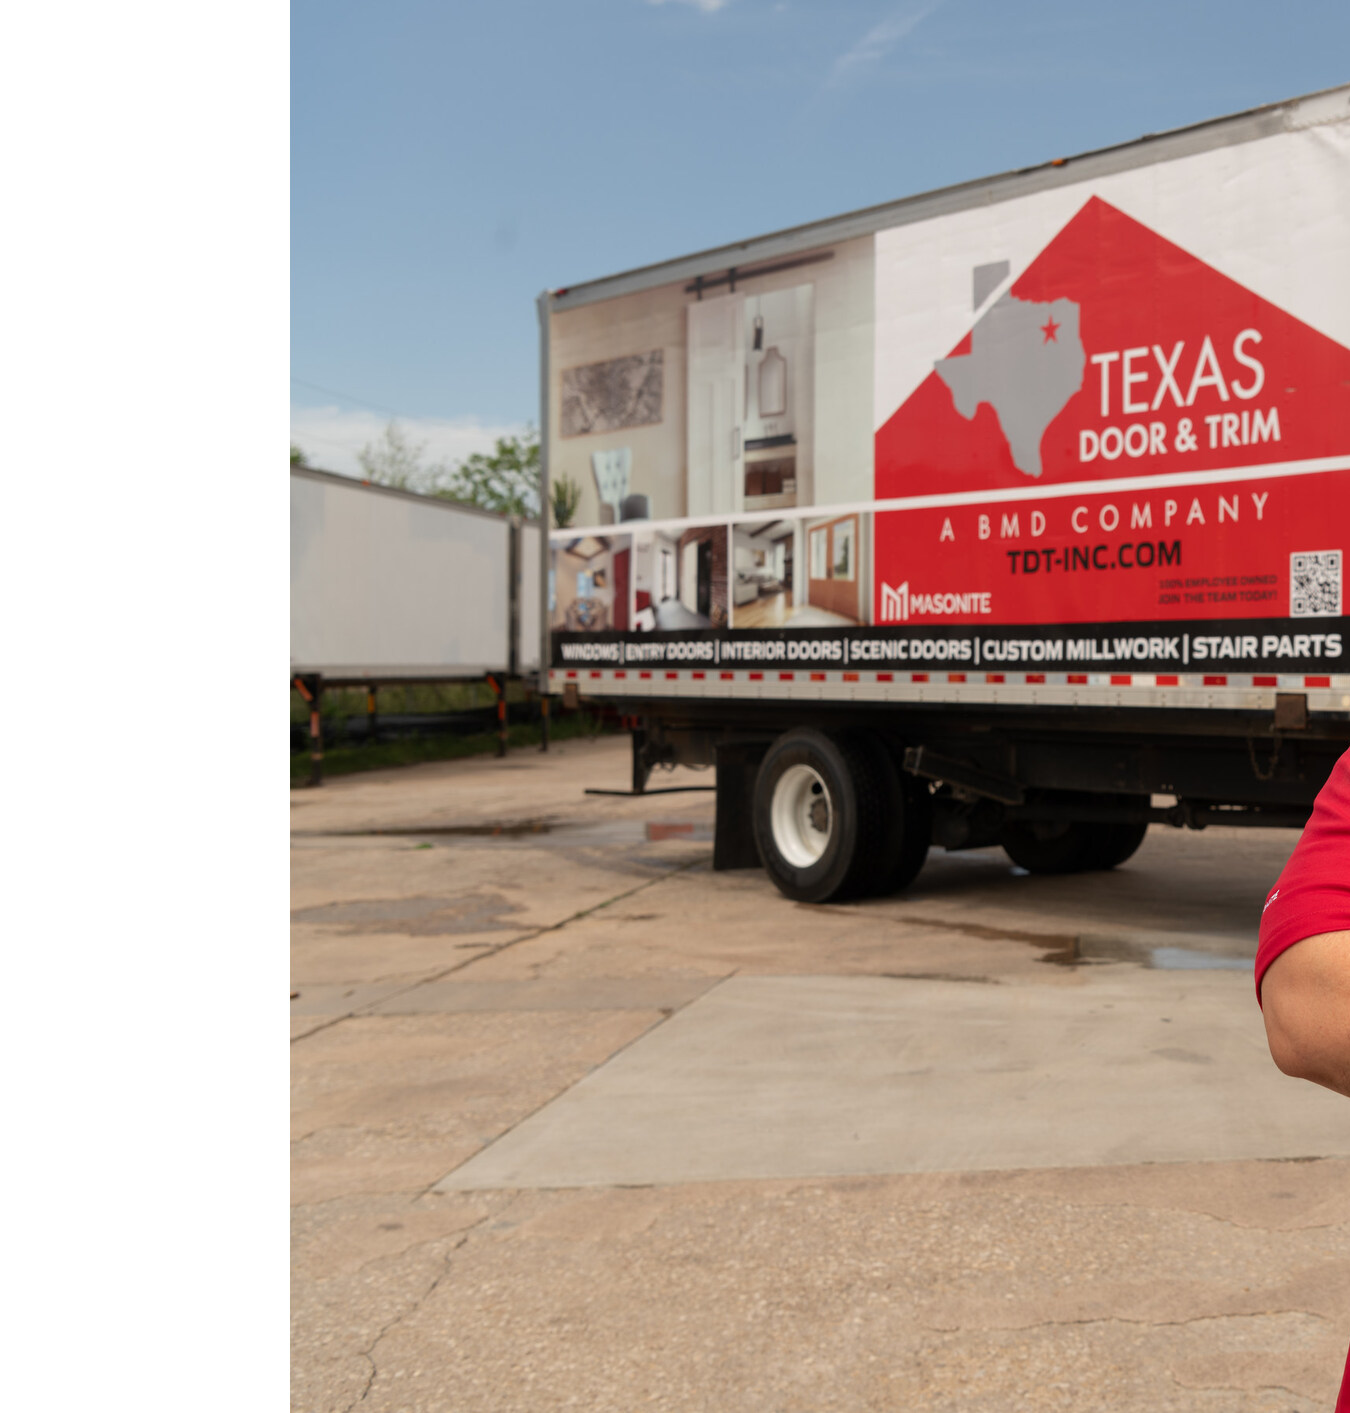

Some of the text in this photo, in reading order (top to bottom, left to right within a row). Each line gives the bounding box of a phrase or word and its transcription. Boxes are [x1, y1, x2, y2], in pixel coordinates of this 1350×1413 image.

[1091, 328, 1264, 417] TEXAS
[1079, 406, 1281, 462] DOOR & TRIM
[939, 492, 1269, 542] A BMD COMPANY
[1006, 540, 1182, 574] TDT-INC.COM
[1185, 576, 1237, 588] EMPLOYEE
[1240, 575, 1278, 586] OWNED
[910, 592, 992, 614] MASONITE
[1159, 590, 1278, 604] JOIN THE TEAM TODAY!
[561, 634, 1342, 661] WINDOWS ENTRY DOORS INTERIOR DOORS SCENIC DOORS CUSTOM MILLWORK STAIR PARTS
